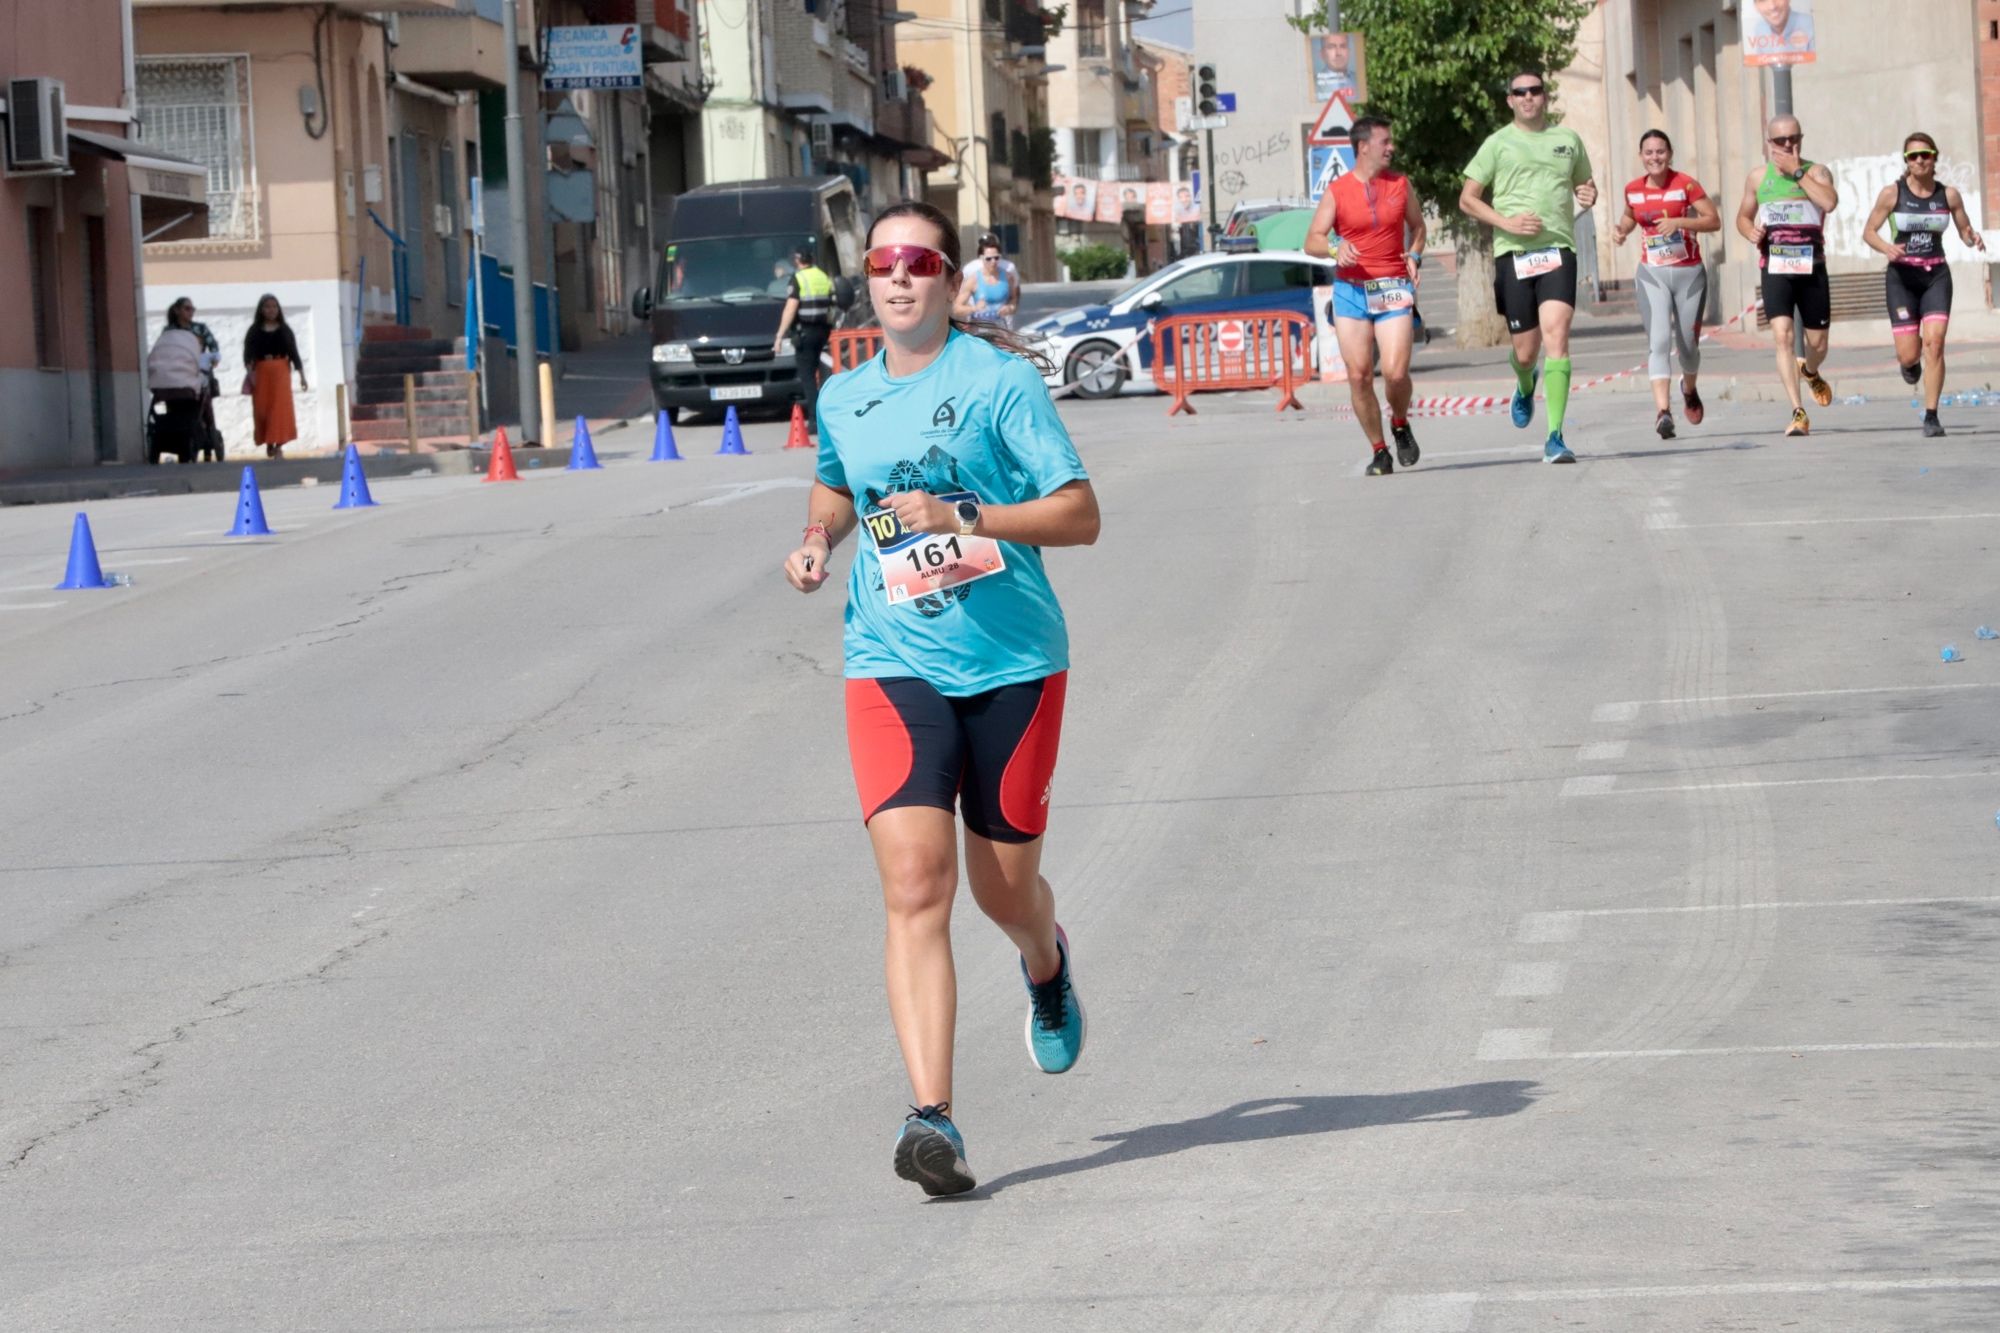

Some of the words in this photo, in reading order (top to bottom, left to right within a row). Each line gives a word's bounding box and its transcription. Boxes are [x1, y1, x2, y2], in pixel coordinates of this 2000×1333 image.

[582, 62, 590, 74] Y
[592, 60, 637, 74] PINTURA
[589, 77, 602, 88] 62
[604, 76, 617, 87] 01
[1527, 255, 1549, 267] 194
[1380, 292, 1403, 304] 168
[906, 535, 964, 573] 161
[921, 567, 945, 580] ALMU
[948, 562, 960, 571] 28
